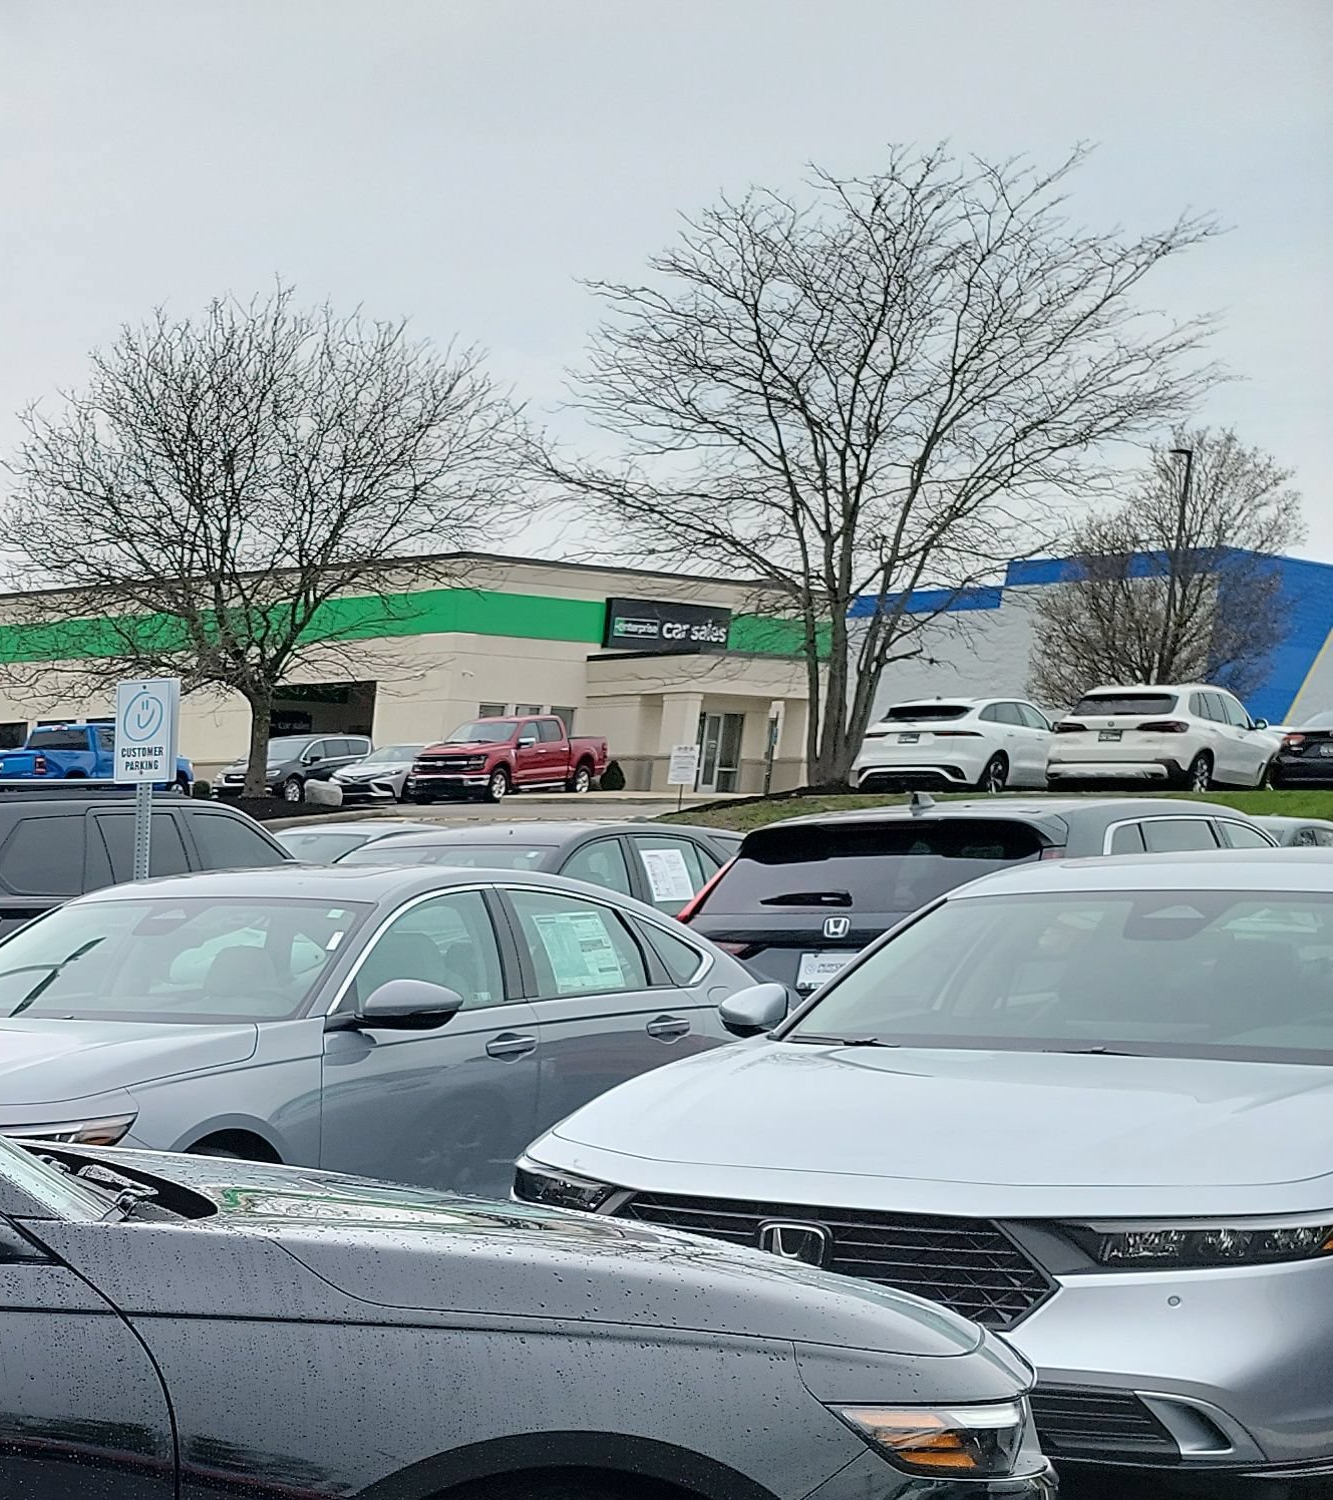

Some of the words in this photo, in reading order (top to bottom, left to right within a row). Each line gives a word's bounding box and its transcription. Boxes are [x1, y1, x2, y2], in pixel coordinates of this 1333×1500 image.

[662, 622, 690, 639] car
[690, 619, 727, 643] sales
[121, 746, 164, 758] CUSTOMER
[125, 760, 159, 771] PARKING
